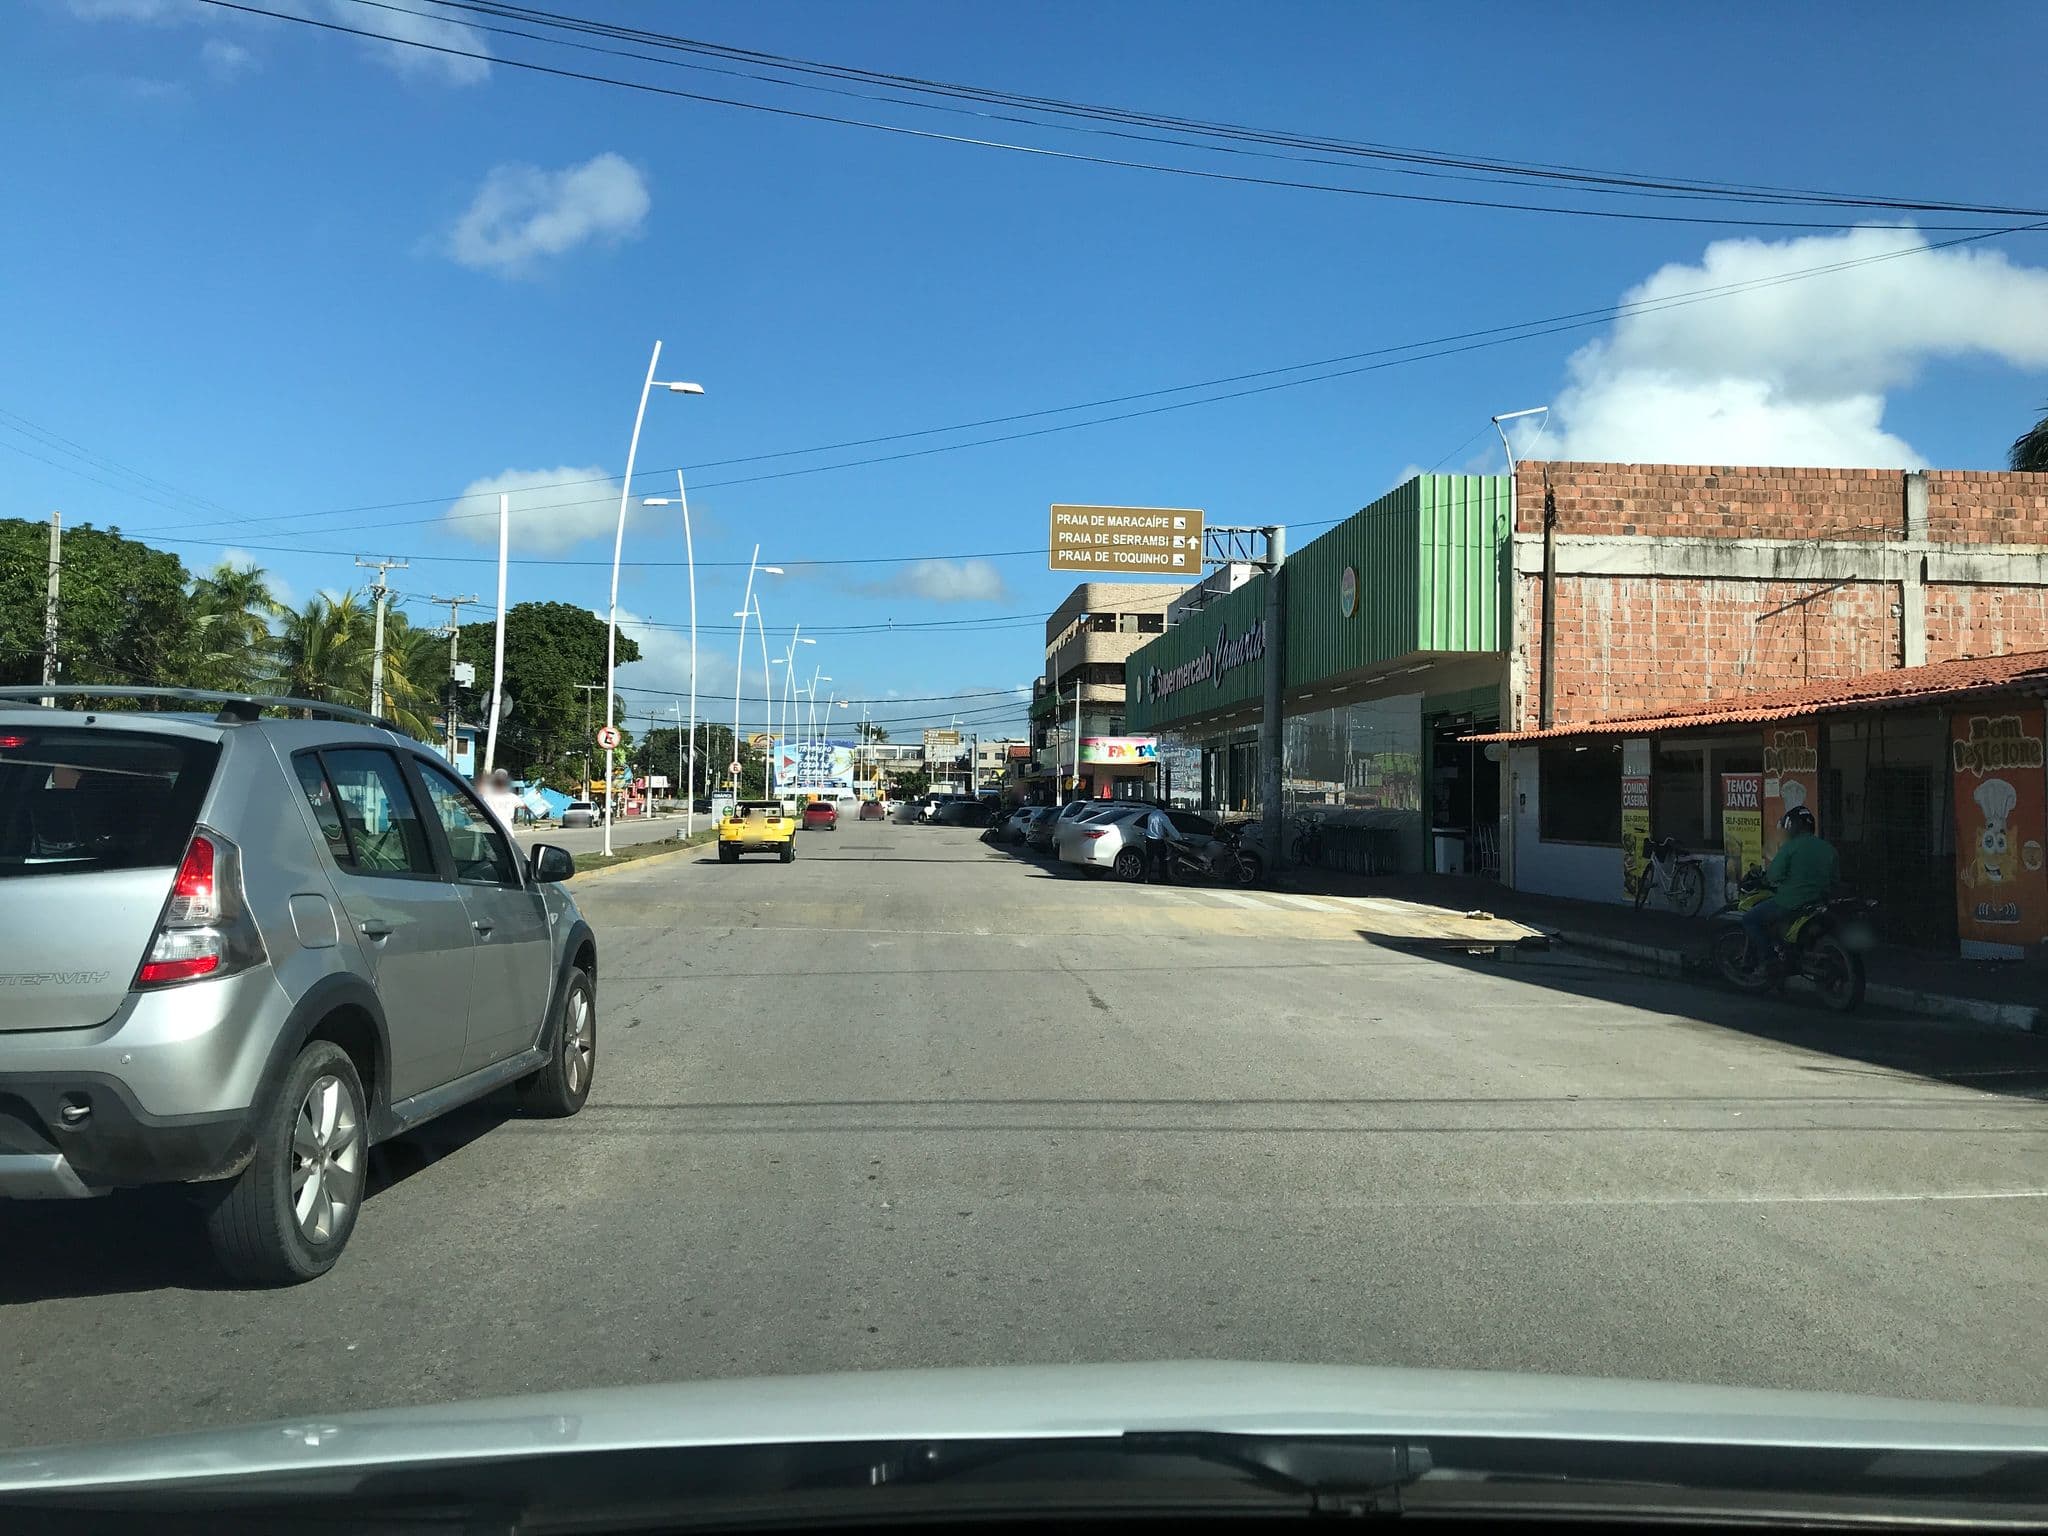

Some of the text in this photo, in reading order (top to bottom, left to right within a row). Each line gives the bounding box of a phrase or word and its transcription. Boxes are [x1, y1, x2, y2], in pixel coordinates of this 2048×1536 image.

[1057, 514, 1169, 528] PRAIA DE MARACAÍPE
[1059, 532, 1169, 547] PRAIA DE SERRAMBI
[1058, 550, 1169, 564] PRAIA DE TOQUINHO
[1157, 646, 1212, 703] Supermercado
[1623, 782, 1647, 795] COMIDA
[1727, 780, 1758, 793] TEMOS
[1623, 794, 1647, 808] CASEIRA
[1727, 793, 1758, 808] JANTA
